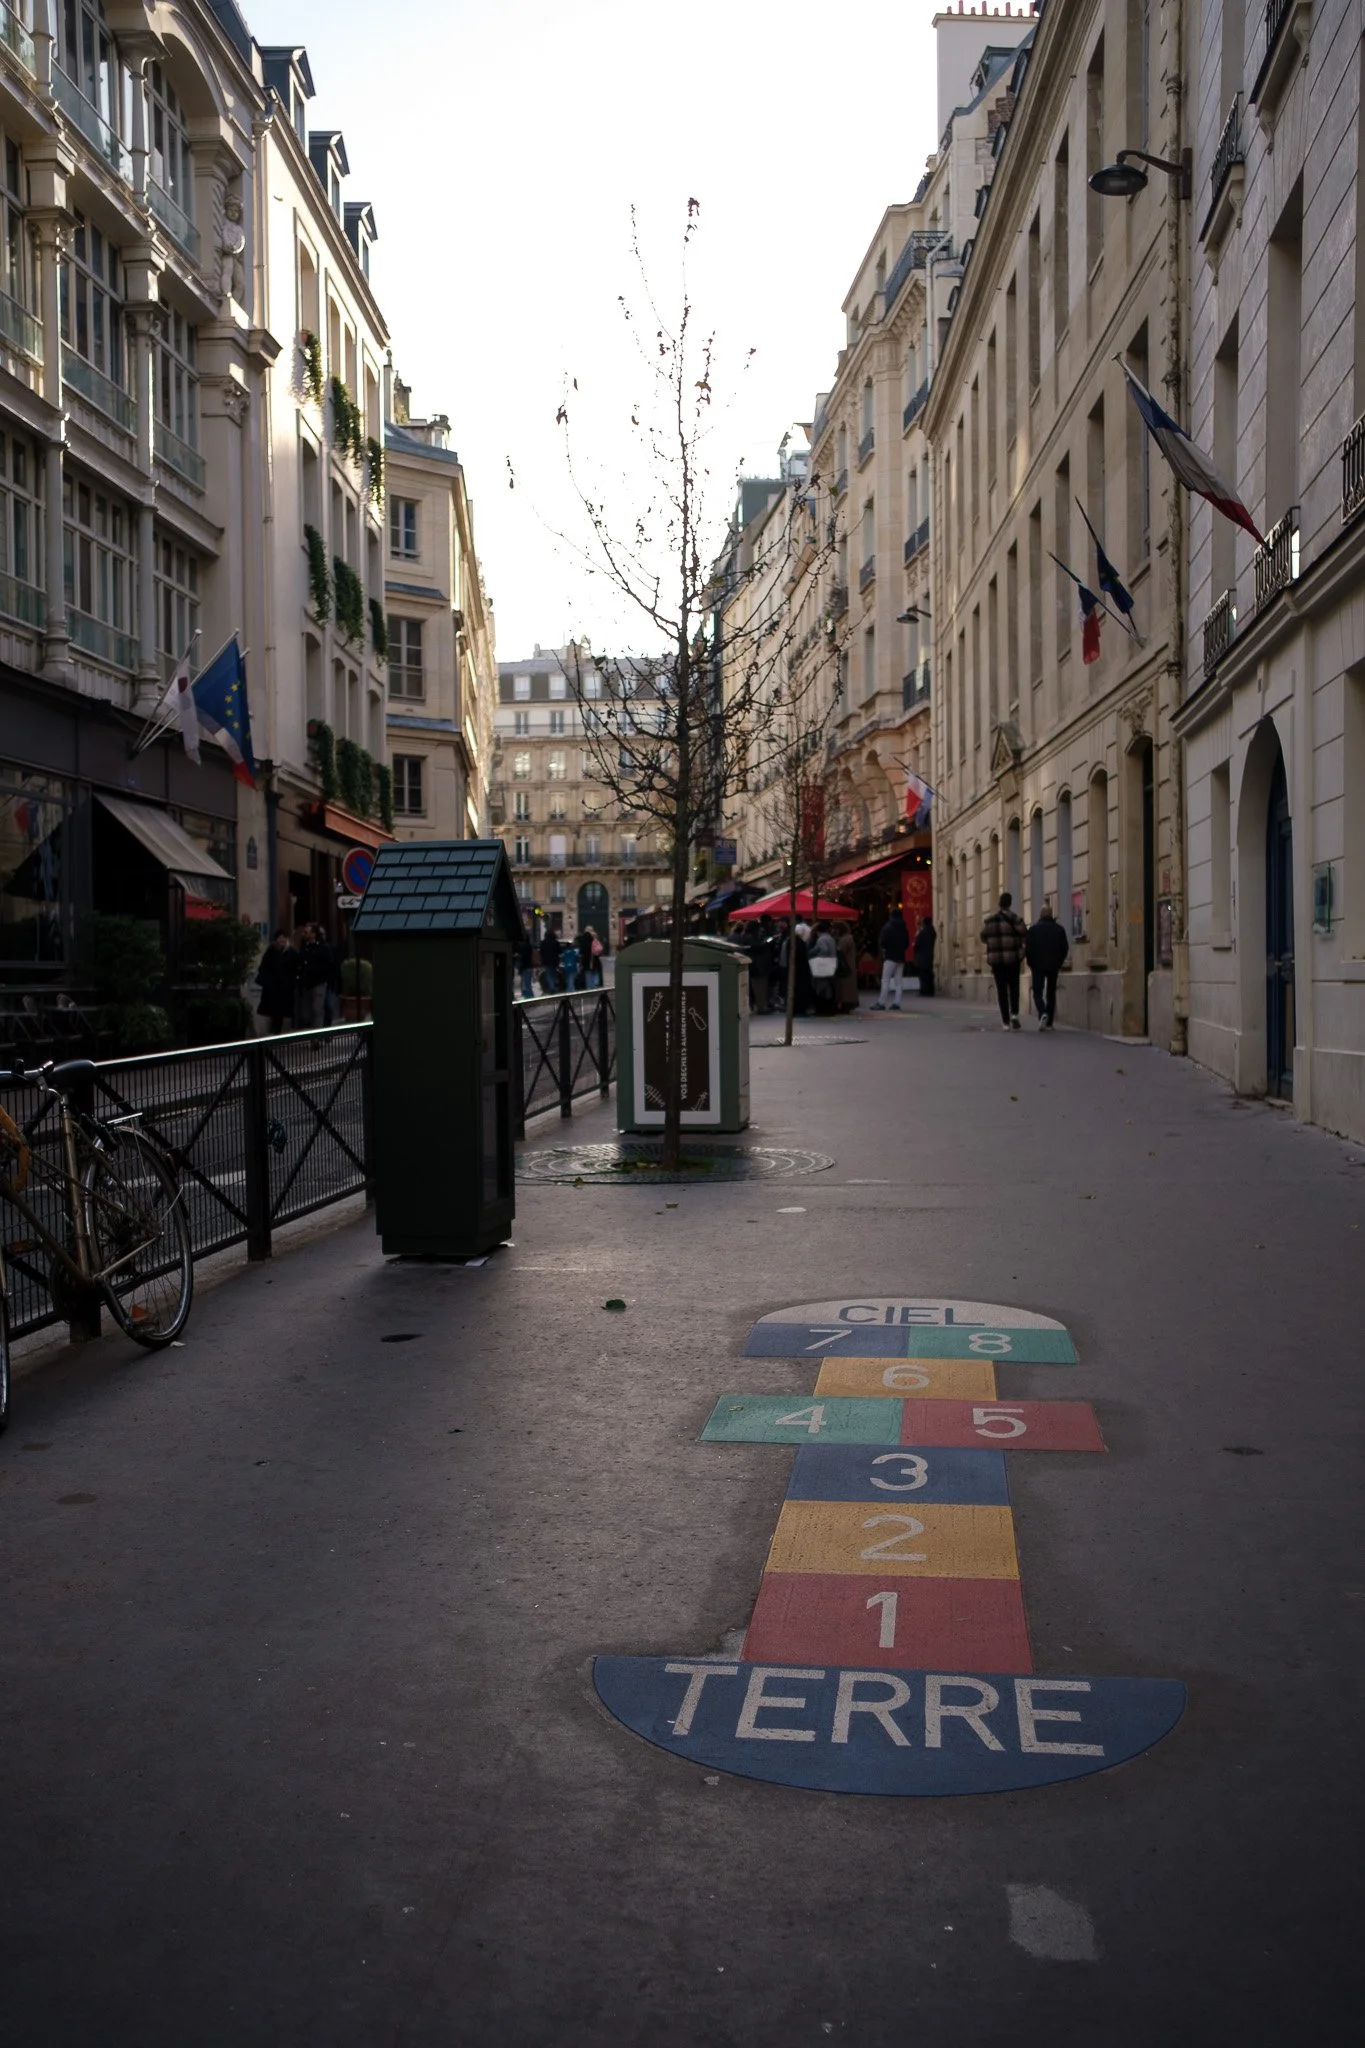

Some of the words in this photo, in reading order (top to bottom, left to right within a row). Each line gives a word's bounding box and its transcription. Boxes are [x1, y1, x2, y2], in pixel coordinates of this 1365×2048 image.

[680, 1084, 688, 1100] VOS
[838, 1305, 985, 1326] CIEL
[804, 1328, 852, 1350] 7
[968, 1332, 1013, 1354] 8
[882, 1364, 930, 1390] 6
[775, 1405, 827, 1434] 4
[972, 1407, 1027, 1439] 5
[869, 1453, 929, 1491] 3
[859, 1514, 927, 1562] 2
[866, 1591, 898, 1649] 1
[664, 1662, 1105, 1757] TERRE
